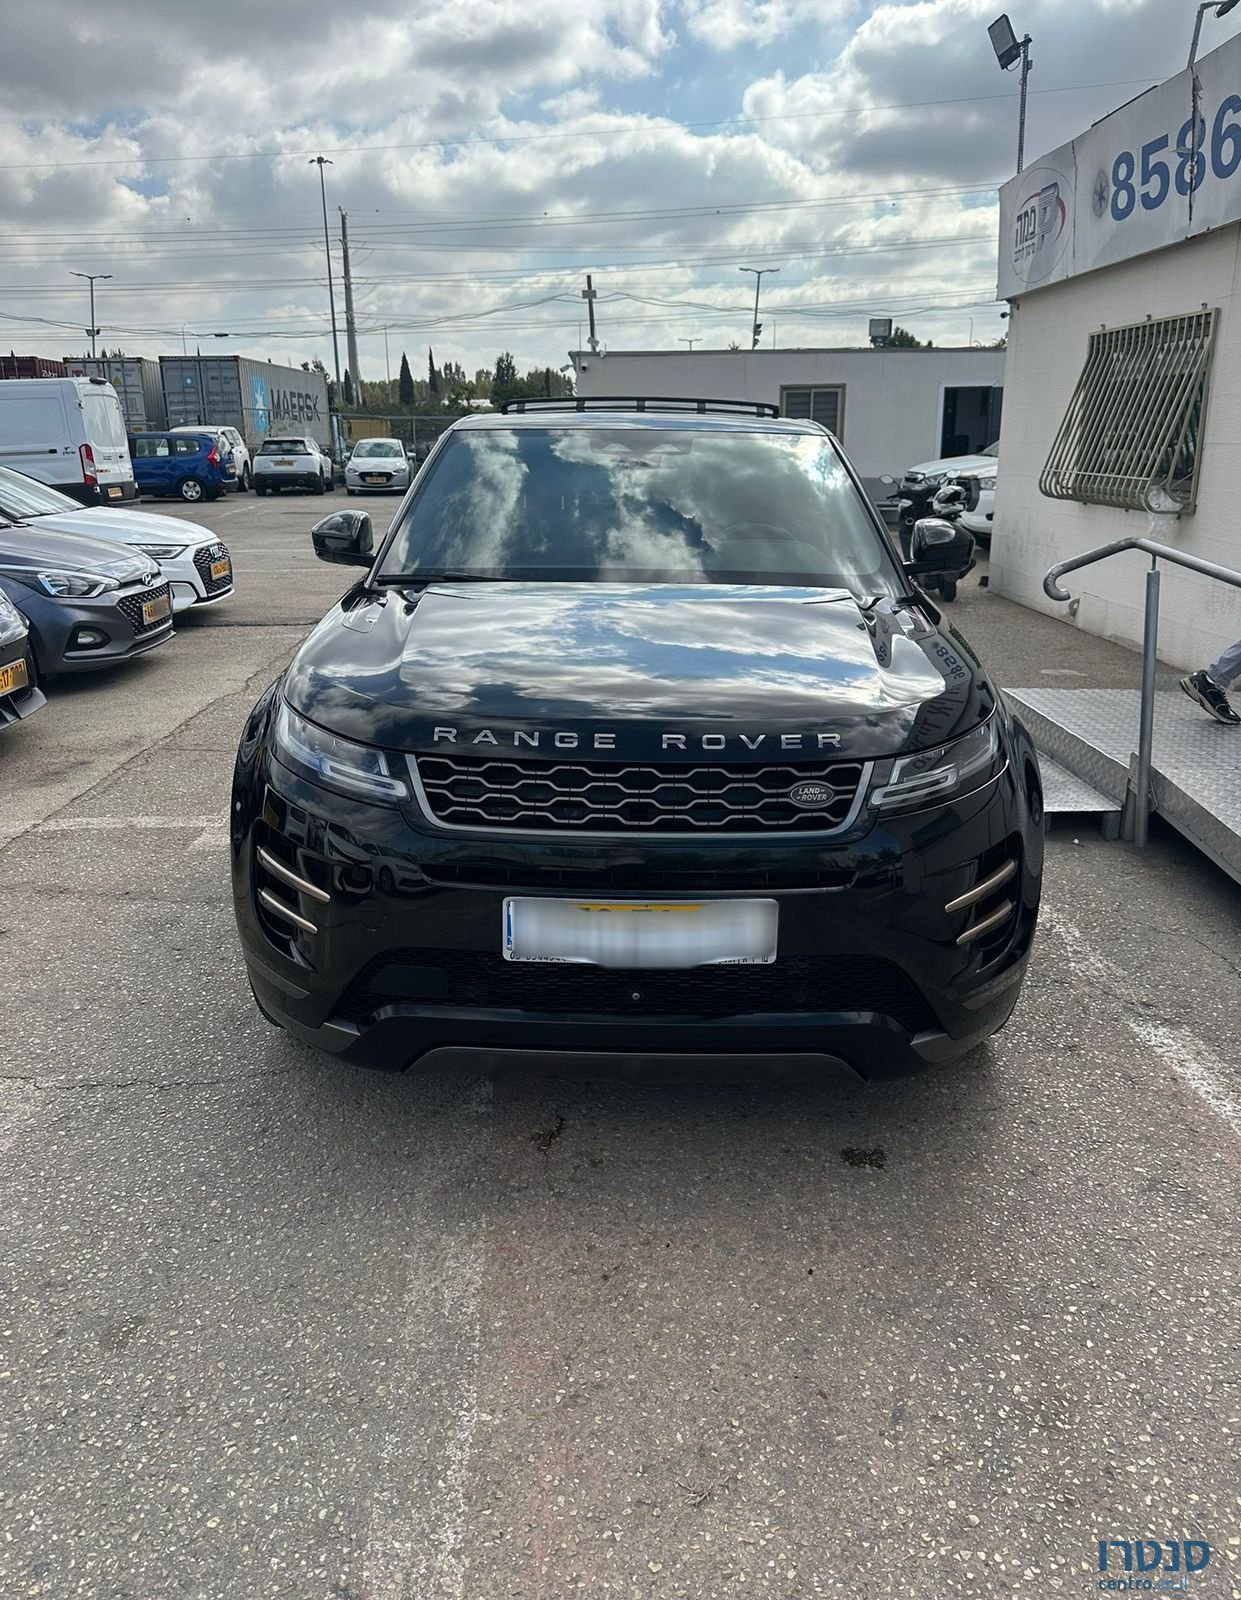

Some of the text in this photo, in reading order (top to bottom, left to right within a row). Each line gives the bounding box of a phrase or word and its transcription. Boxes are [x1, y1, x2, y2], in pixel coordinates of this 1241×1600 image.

[270, 388, 321, 423] MAERSK
[432, 726, 842, 750] RANGE ROVER
